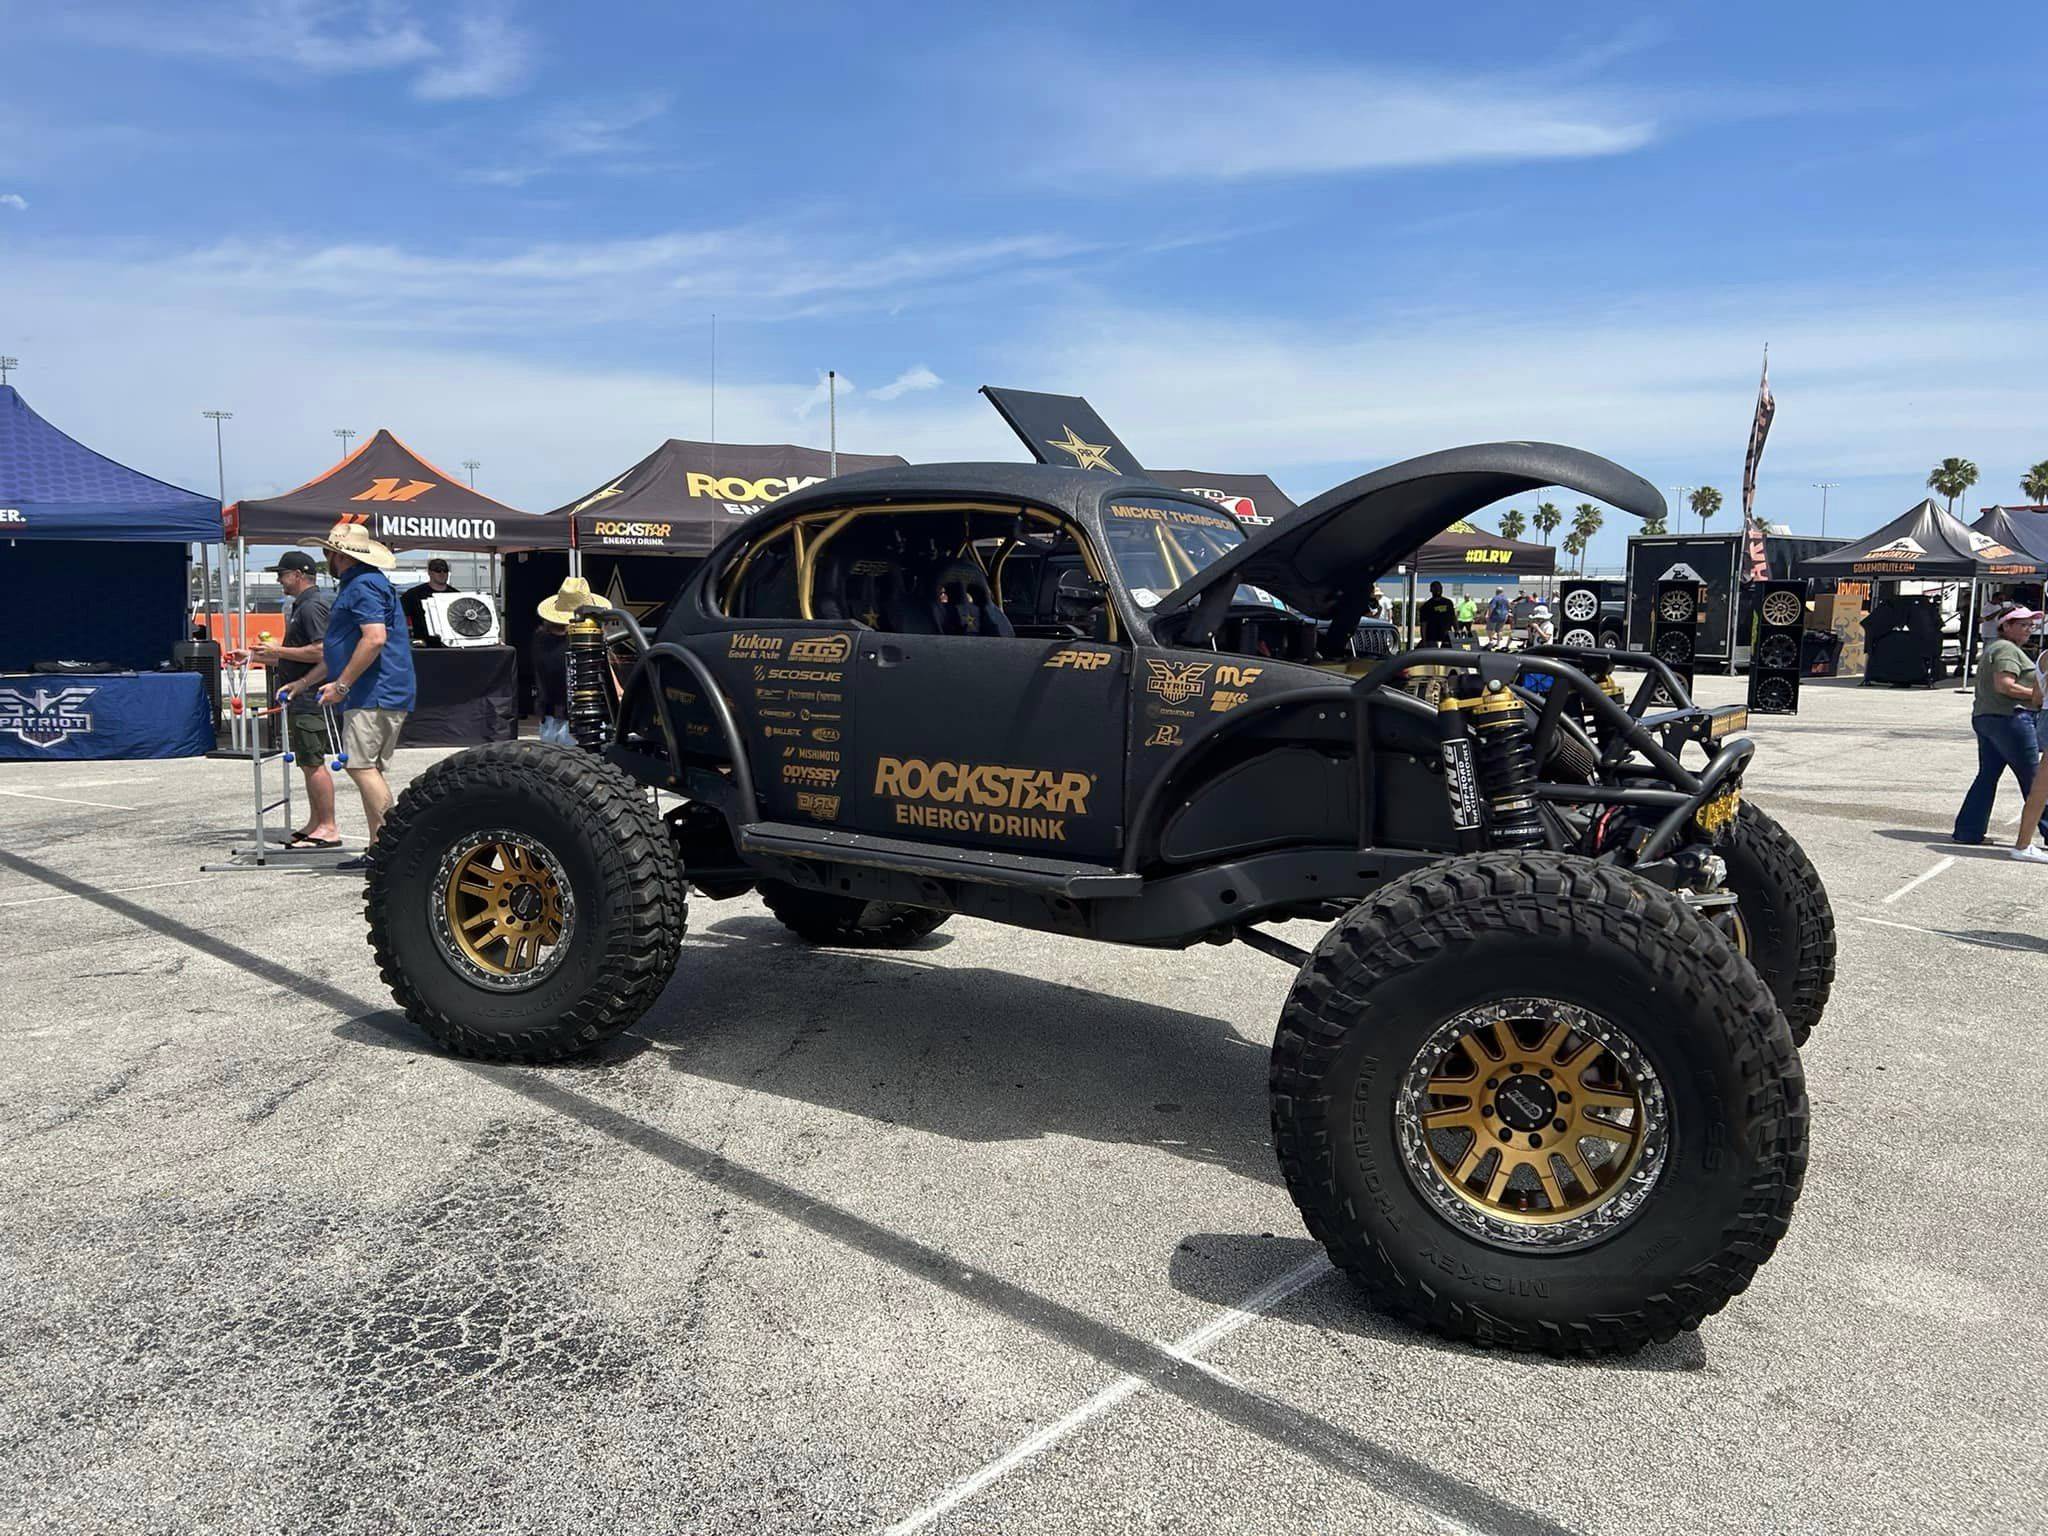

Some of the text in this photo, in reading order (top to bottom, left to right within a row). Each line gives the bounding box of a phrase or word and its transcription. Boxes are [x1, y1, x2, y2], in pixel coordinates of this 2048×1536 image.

[1111, 505, 1168, 520] MICKEY
[1168, 511, 1237, 532] THOMPSON
[382, 515, 496, 540] MISHIMOTO
[594, 521, 672, 537] ROCKSTAR
[602, 537, 665, 546] ENERGY DRINK
[1465, 549, 1512, 564] #DLRW
[731, 634, 783, 649] Yukon
[728, 650, 749, 659] Gear
[759, 650, 780, 660] Axle
[1043, 650, 1111, 670] PRP
[767, 669, 843, 682] SCOSCHE
[1151, 680, 1200, 692] PATRIOT
[0, 717, 84, 728] PATRIOT
[799, 748, 840, 762] MISHIMOTO
[783, 765, 840, 781] ODYSSEY
[783, 777, 837, 788] BATTERY
[873, 757, 1091, 814] ROCKSTAR
[1443, 744, 1464, 826] KING
[1458, 761, 1472, 813] OFF-ROAD
[1462, 743, 1479, 823] RACING SHOCKS
[896, 804, 1066, 841] ENERGY DRINK
[1351, 1055, 1551, 1299] MICKEY THOMPSON
